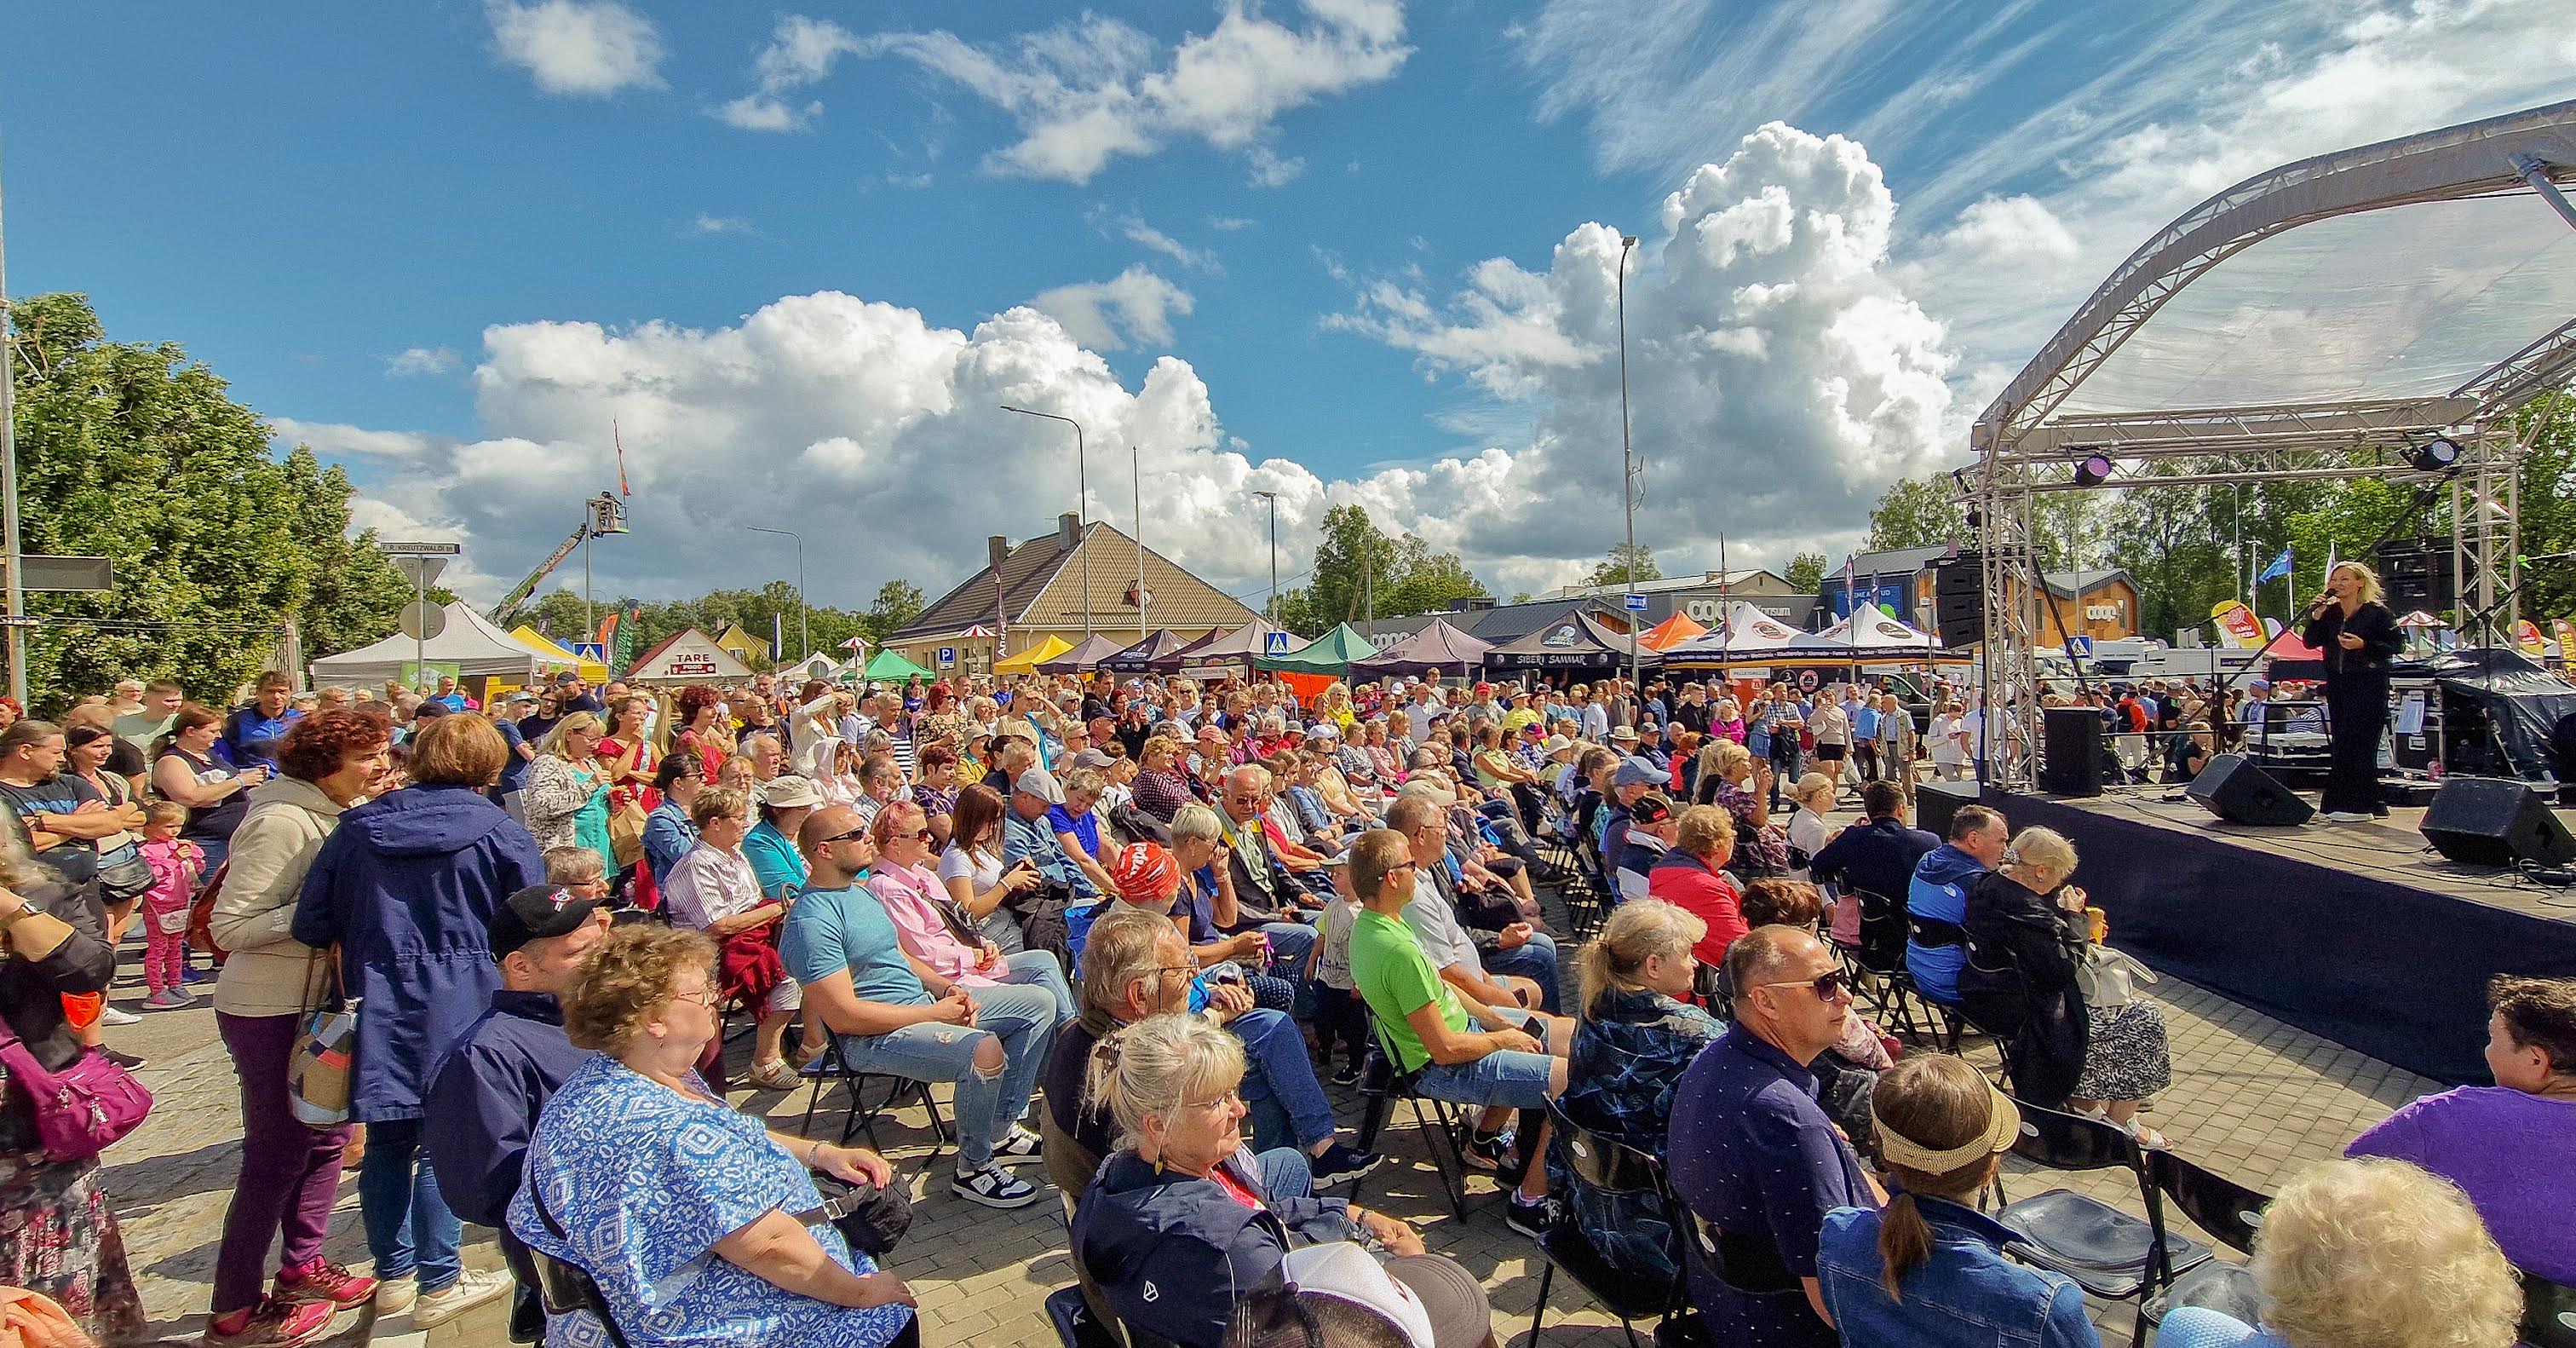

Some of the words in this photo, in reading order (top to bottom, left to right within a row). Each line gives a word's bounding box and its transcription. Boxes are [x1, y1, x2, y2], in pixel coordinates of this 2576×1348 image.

[676, 654, 710, 663] TARE
[942, 648, 951, 661] P
[1516, 655, 1544, 665] SIBERI
[1549, 654, 1588, 665] SAMMAR
